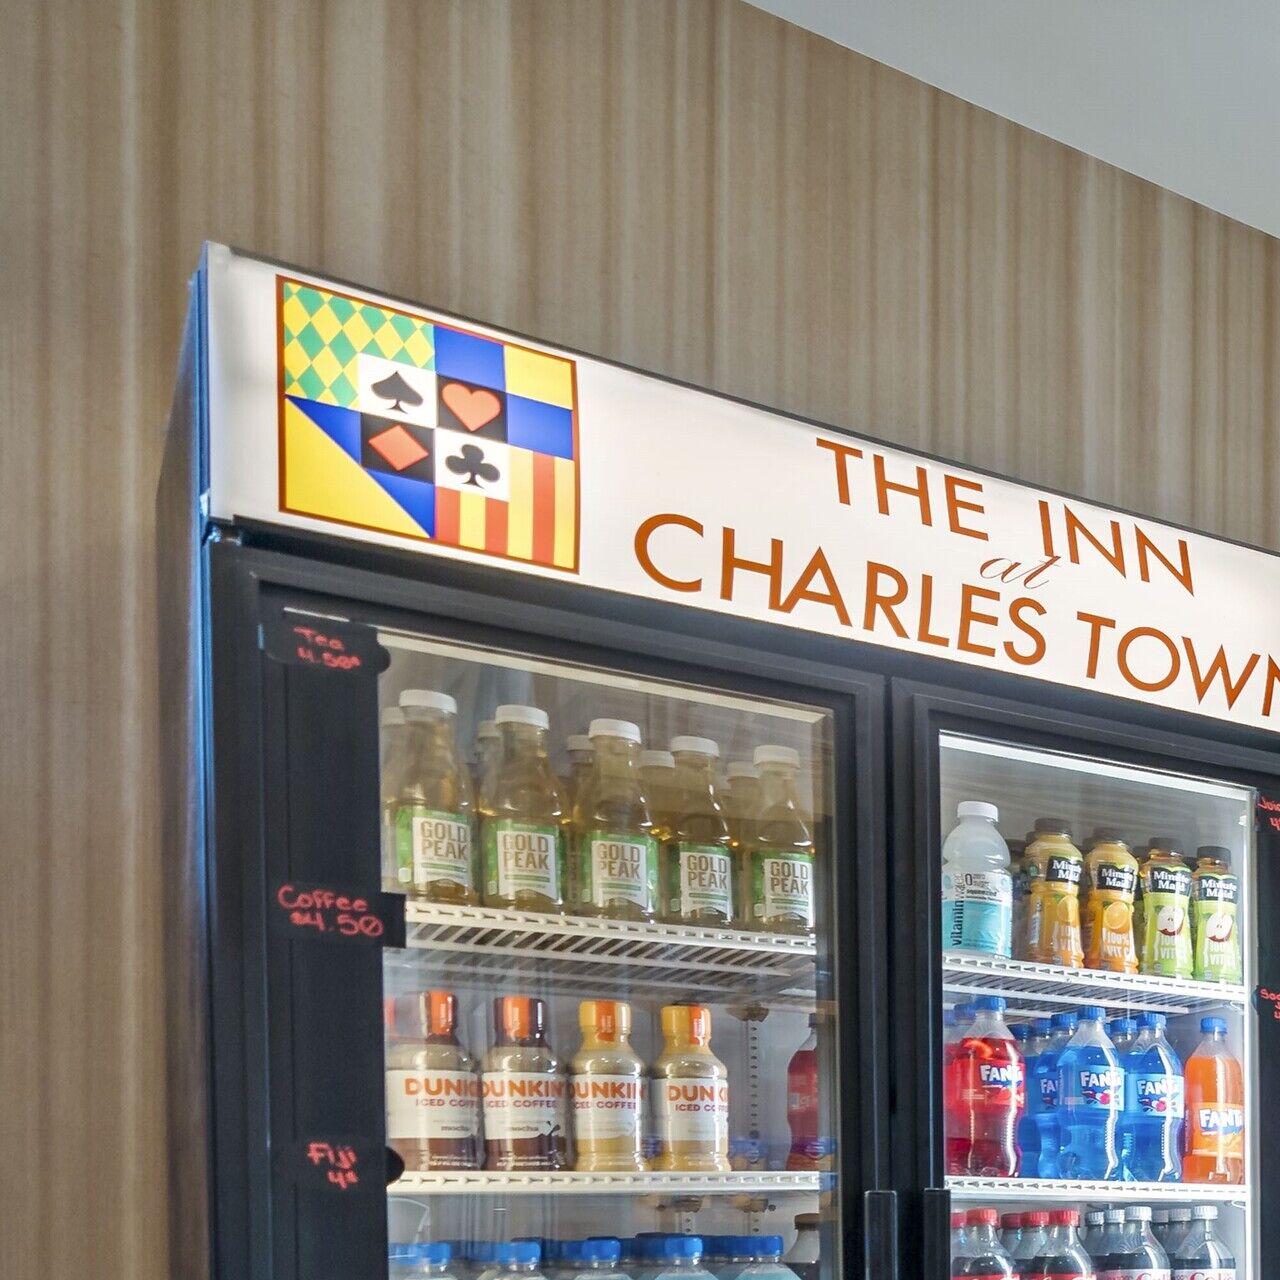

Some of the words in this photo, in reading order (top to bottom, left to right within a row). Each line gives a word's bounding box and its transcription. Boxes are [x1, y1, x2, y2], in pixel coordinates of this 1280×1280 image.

[816, 436, 989, 542] THE
[1037, 498, 1196, 597] INN
[979, 552, 1058, 588] at
[632, 512, 1047, 667] CHARLES
[293, 626, 345, 652] Tea
[420, 820, 468, 844] GOLD
[421, 836, 469, 861] PEAK
[502, 850, 549, 870] PEAK
[597, 861, 640, 880] PEAK
[686, 853, 728, 876] GOLD
[769, 860, 810, 880] GOLD
[687, 870, 728, 890] PEAK
[770, 876, 810, 896] PEAK
[277, 884, 369, 912] Coffee
